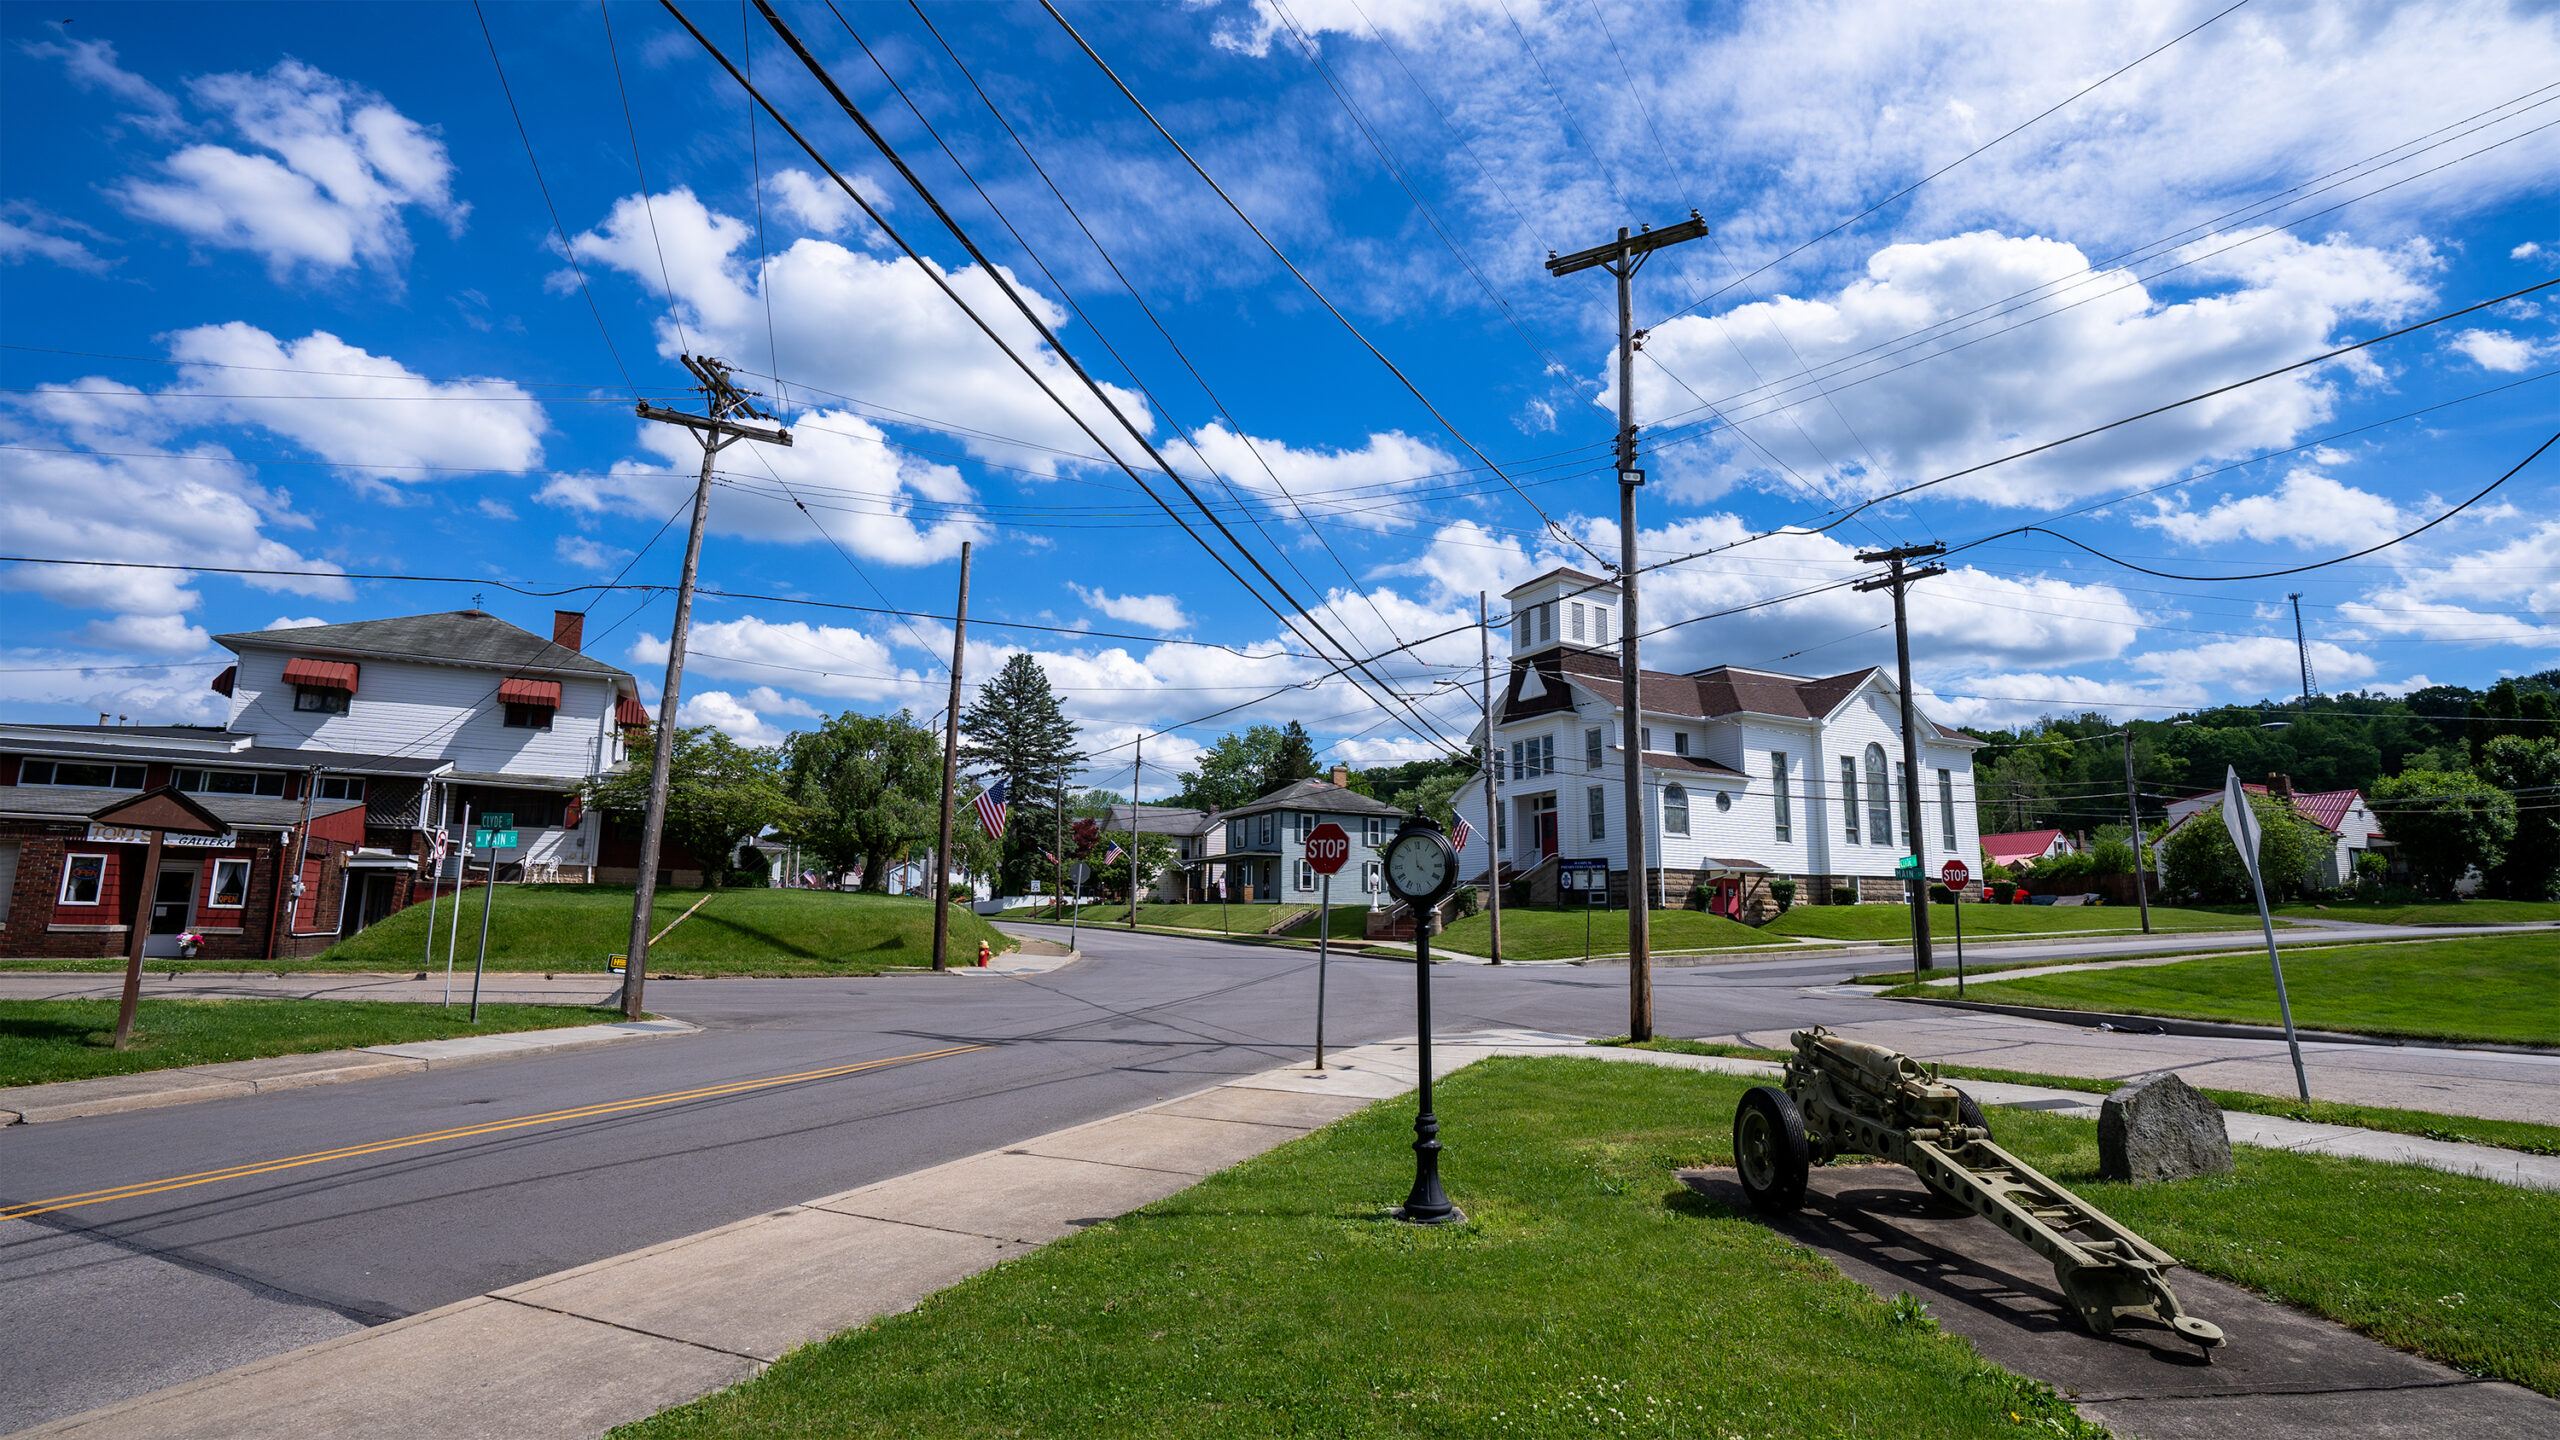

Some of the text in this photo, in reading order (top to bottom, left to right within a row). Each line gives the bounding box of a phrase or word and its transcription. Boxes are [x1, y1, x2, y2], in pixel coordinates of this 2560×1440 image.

[482, 816, 503, 828] CLYDE
[178, 837, 235, 847] GALLERY
[485, 833, 506, 845] MAIN
[1308, 839, 1347, 858] STOP
[1896, 870, 1913, 878] MAIN
[1943, 869, 1967, 881] STOP
[218, 894, 237, 903] OPEN
